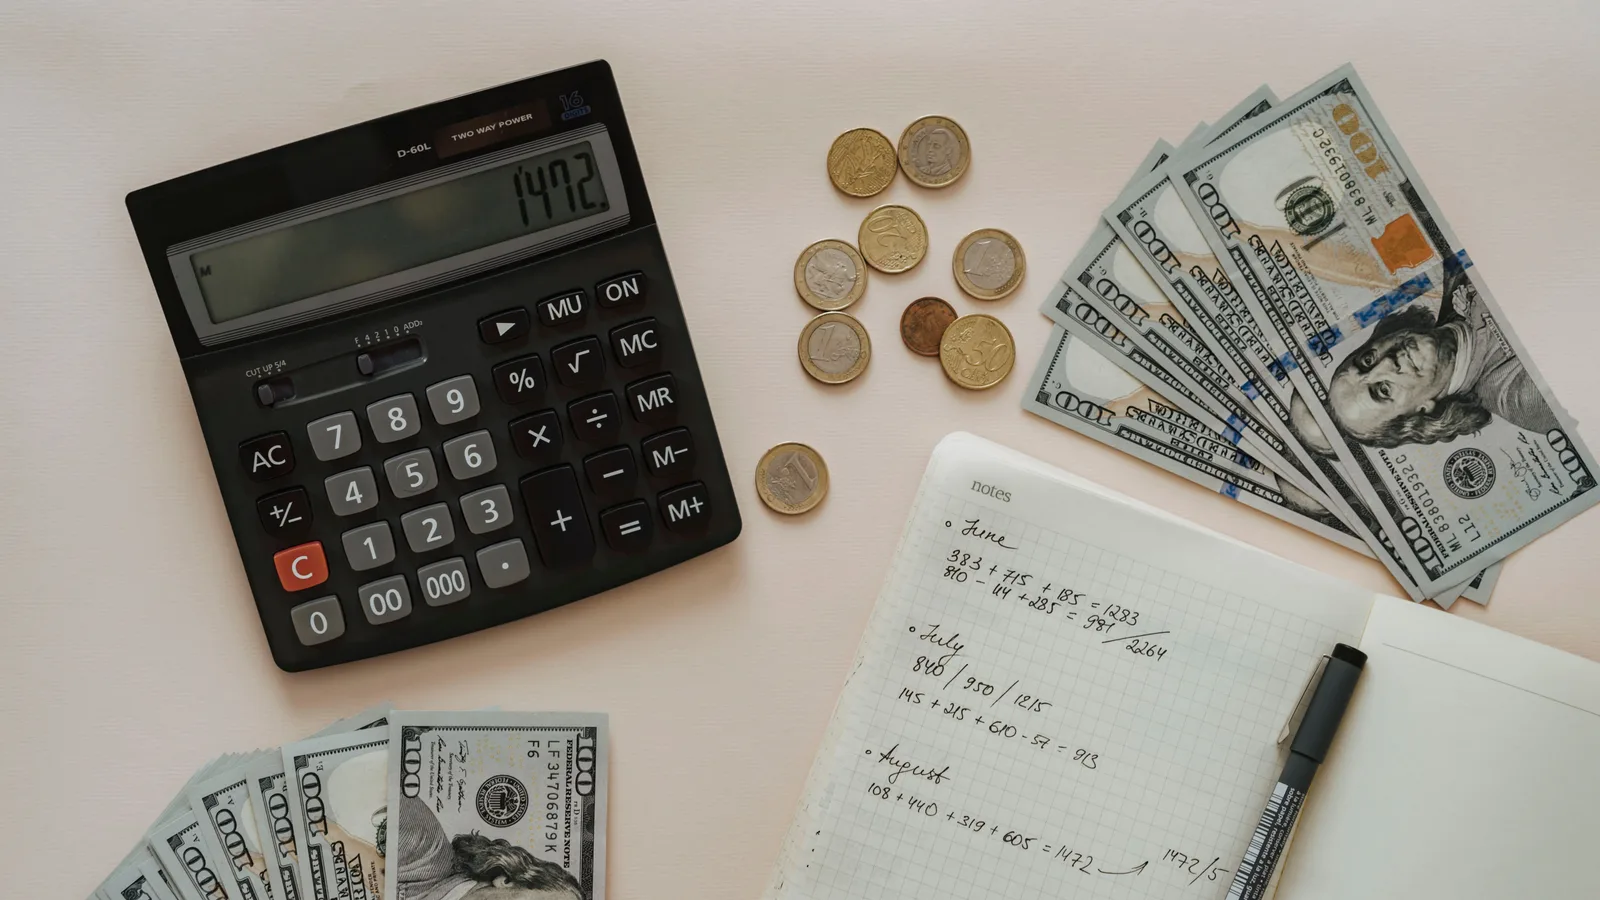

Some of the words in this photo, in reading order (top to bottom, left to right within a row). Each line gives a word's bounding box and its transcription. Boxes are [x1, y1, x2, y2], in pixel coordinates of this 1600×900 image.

[559, 90, 584, 111] 16
[451, 130, 475, 142] TWO
[476, 123, 497, 135] WAY
[498, 113, 533, 129] POWER
[1311, 126, 1325, 139] C
[1328, 99, 1390, 182] 100
[397, 142, 431, 158] D-60L
[1317, 137, 1366, 207] 83801932
[1194, 179, 1241, 241] 100
[1359, 205, 1377, 226] ML
[1129, 216, 1182, 275] 100
[1230, 248, 1273, 312] DOLLARS
[1245, 232, 1295, 303] STATES
[1266, 239, 1324, 324] AMERICA
[605, 277, 639, 302] ON
[1092, 274, 1151, 329] 100
[1187, 263, 1244, 329] STATES
[1265, 284, 1296, 327] THE
[547, 294, 583, 321] MU
[1173, 281, 1220, 336] DOLLARS
[1071, 299, 1132, 349] 100
[1157, 311, 1221, 369] STATES
[1214, 312, 1247, 351] THE
[1285, 297, 1335, 368] UNITED
[1314, 318, 1338, 347] OF
[1486, 318, 1508, 350] FRANKLIN
[619, 329, 658, 357] MC
[1145, 331, 1203, 383] DOLLARS
[1235, 322, 1293, 388] UNITED
[1268, 310, 1311, 373] HUNDRED
[246, 366, 262, 378] CUT
[263, 363, 273, 374] UP
[274, 359, 287, 370] 5/4
[1191, 355, 1230, 391] THE
[1218, 337, 1269, 397] HUNDRED
[446, 388, 465, 414] 9
[637, 386, 674, 413] MR
[1305, 371, 1327, 401] ONE
[388, 407, 408, 431] 8
[1052, 387, 1116, 428] 100
[1201, 378, 1259, 431] HUNDRED
[1266, 394, 1289, 421] ONE
[326, 424, 344, 451] 7
[1123, 404, 1197, 445] STATES
[1257, 426, 1284, 452] ONE
[252, 444, 286, 474] AC
[463, 443, 483, 469] 6
[1118, 427, 1183, 461] DOLLARS
[1168, 436, 1214, 462] THE
[1394, 453, 1407, 465] C
[1543, 424, 1589, 487] 100
[405, 461, 424, 489] 5
[1185, 455, 1255, 491] HUNDRED
[1377, 448, 1397, 475] NOTE
[345, 479, 364, 505] 4
[971, 479, 1013, 503] notes
[1253, 485, 1284, 504] ONE
[1393, 473, 1423, 518] RESERVE
[1401, 463, 1450, 533] 83801932
[482, 499, 500, 524] 3
[667, 496, 704, 521] M+
[422, 517, 442, 543] 2
[961, 518, 1018, 550] June
[1397, 512, 1445, 575] 100
[1419, 515, 1449, 559] FEDERAL
[1443, 532, 1462, 553] ML
[1457, 513, 1481, 542] L12
[362, 536, 379, 561] 1
[292, 555, 313, 580] C
[426, 569, 466, 600] 000
[947, 549, 983, 571] 383
[1003, 570, 1033, 587] 715
[1057, 588, 1087, 606] 185
[1103, 603, 1139, 627] 1283
[369, 588, 402, 616] 00
[310, 610, 328, 635] 0
[1083, 614, 1116, 634] 981
[919, 624, 966, 666] July
[1126, 639, 1168, 662] 2264
[912, 656, 945, 677] 840
[963, 676, 994, 697] 950
[1013, 693, 1053, 713] 1215
[899, 687, 926, 705] 145
[943, 703, 972, 721] 215
[988, 720, 1017, 738] 610
[1073, 748, 1100, 770] 913
[527, 740, 539, 758] F6
[547, 740, 559, 758] LF
[575, 733, 593, 796] 100
[879, 743, 951, 785] August
[402, 735, 421, 798] 100
[300, 770, 328, 837] 100
[545, 762, 558, 840] 34706879
[1283, 786, 1295, 806] sobre
[212, 805, 255, 872] 100
[266, 791, 299, 858] 100
[867, 782, 890, 800] 108
[907, 796, 938, 817] 440
[957, 814, 986, 833] 319
[1003, 830, 1038, 852] 605
[1054, 844, 1096, 876] 1472
[544, 844, 556, 853] K
[1260, 826, 1278, 859] resistente
